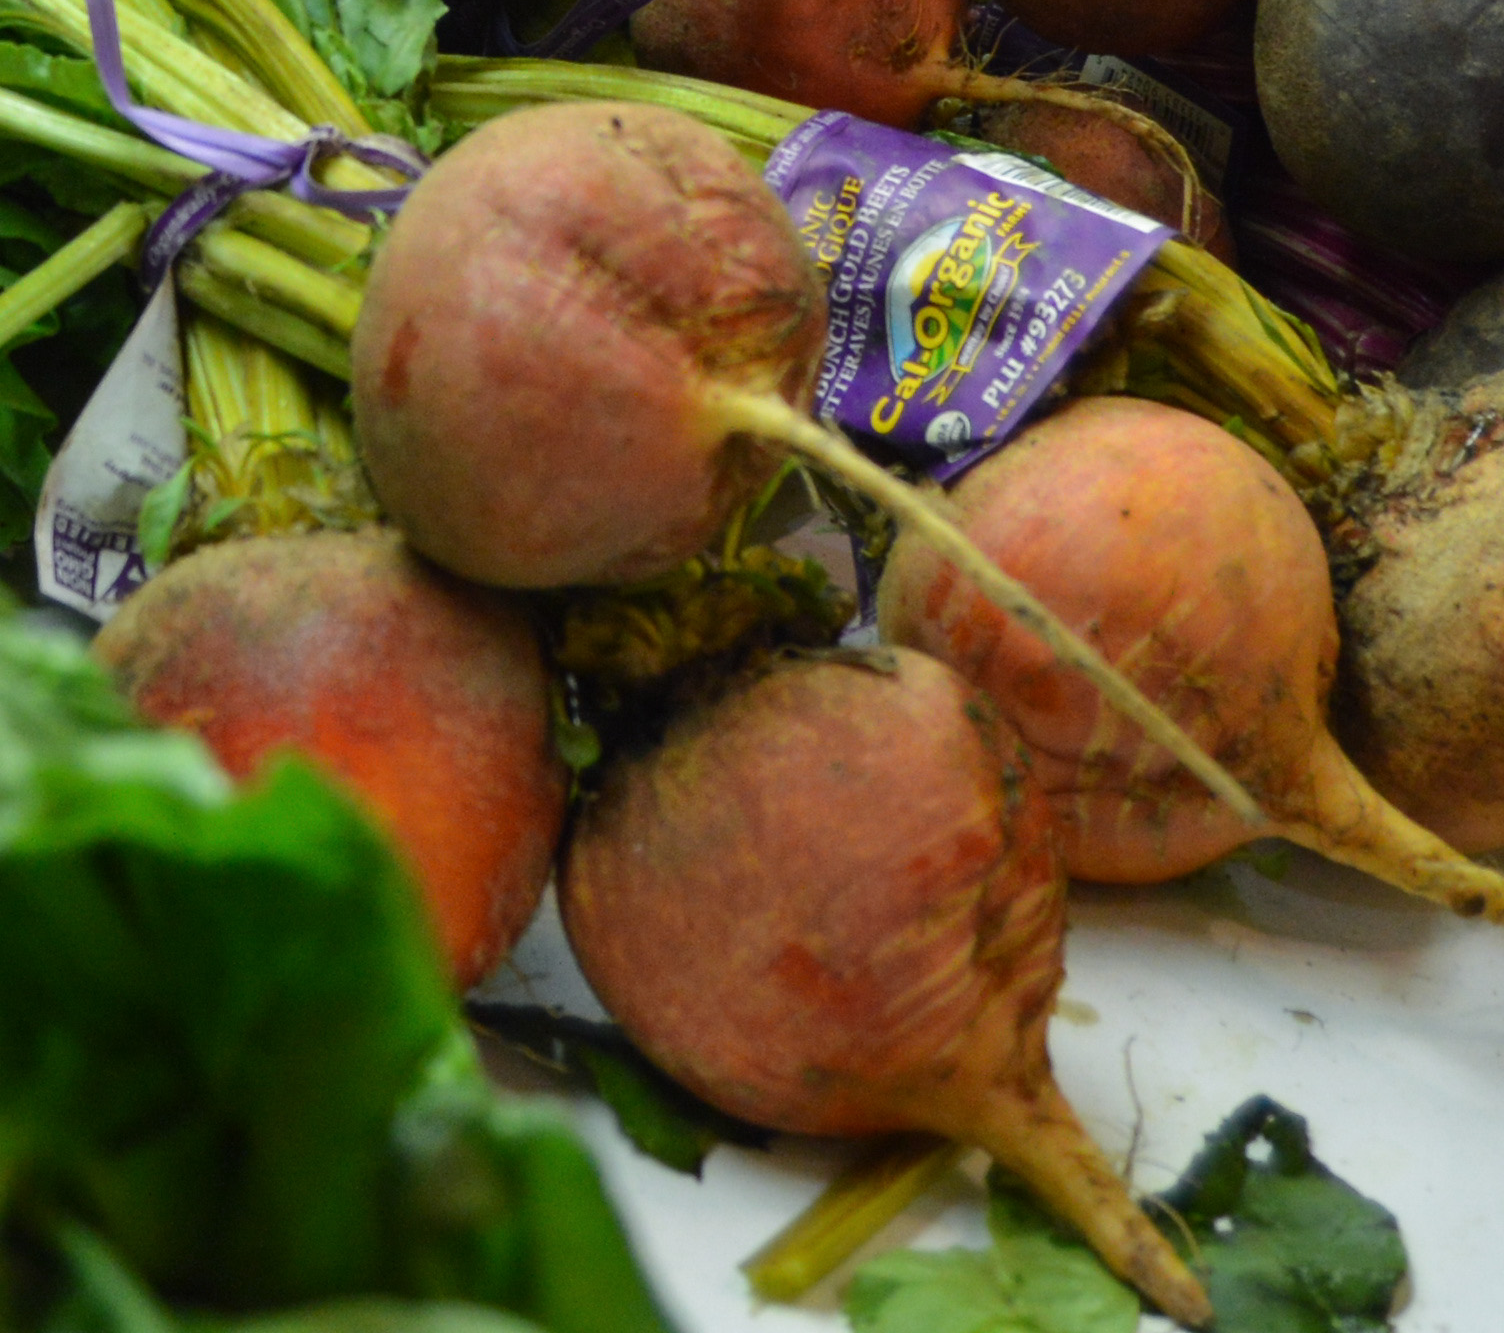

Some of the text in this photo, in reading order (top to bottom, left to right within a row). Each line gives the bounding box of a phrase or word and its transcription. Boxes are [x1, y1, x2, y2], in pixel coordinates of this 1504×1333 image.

[765, 140, 803, 186] Pride
[834, 223, 872, 306] GOLD
[859, 163, 912, 226] BEETS
[862, 229, 893, 306] JAUNES
[888, 199, 909, 232] EN
[901, 157, 948, 207] BOTTE
[995, 201, 1033, 240] FARMS
[870, 190, 1015, 435] Cal-Organic
[980, 267, 1088, 410] PLU #93273
